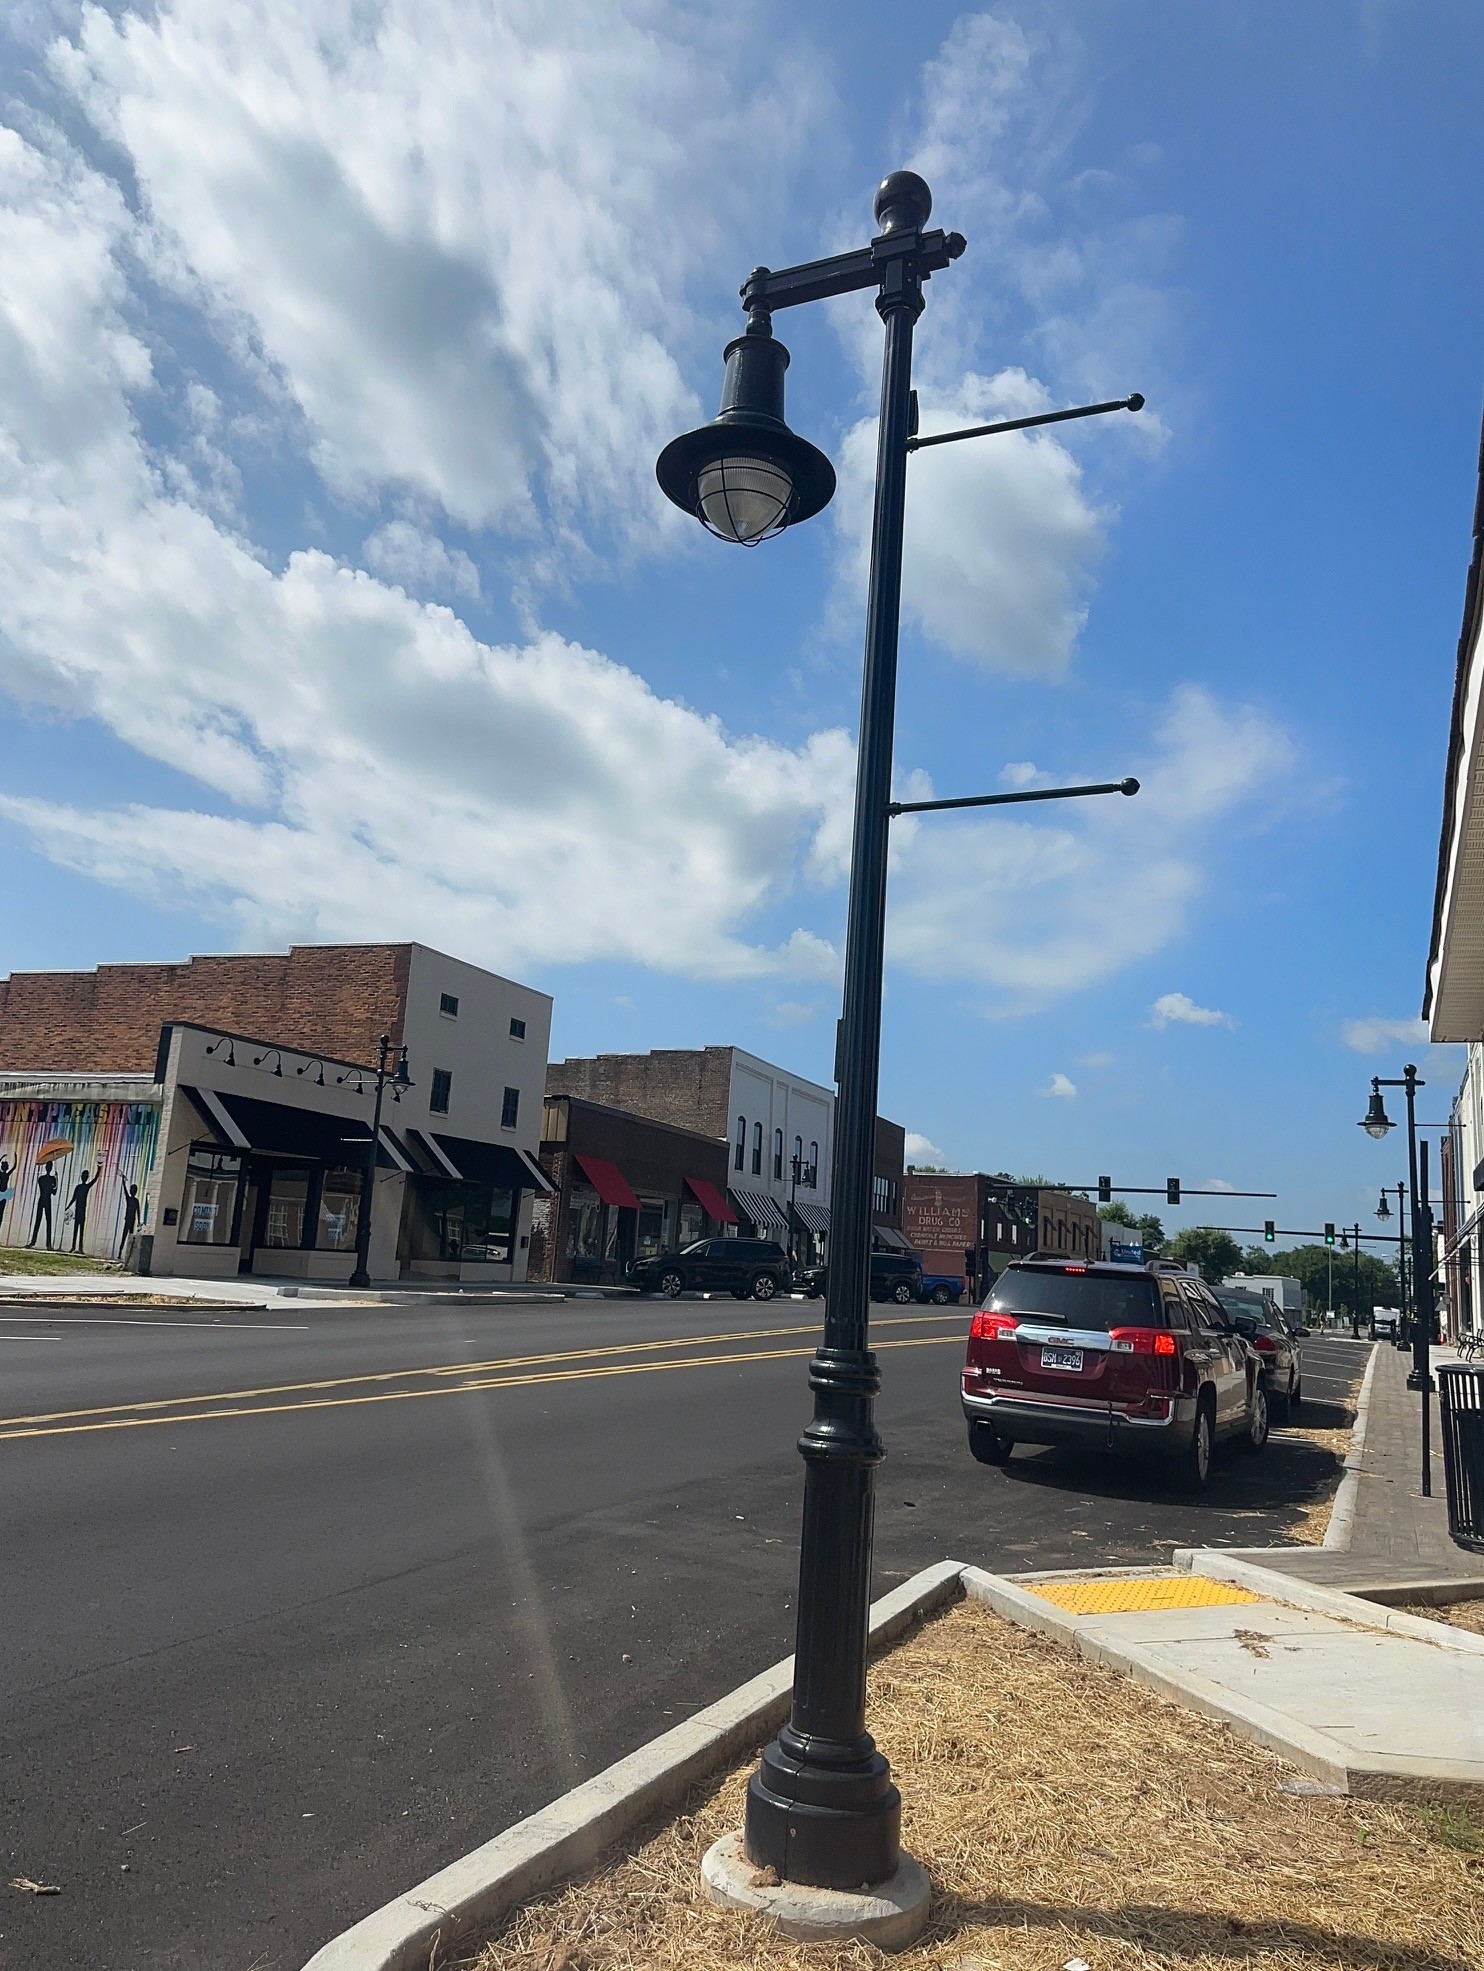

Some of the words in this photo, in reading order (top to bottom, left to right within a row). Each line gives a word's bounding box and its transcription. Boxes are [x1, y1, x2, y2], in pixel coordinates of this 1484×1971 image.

[907, 1206, 970, 1217] WILLIAMS
[918, 1216, 943, 1226] DRUG
[948, 1217, 960, 1227] CO
[1043, 1352, 1057, 1363] BSM
[1062, 1354, 1080, 1366] 2396
